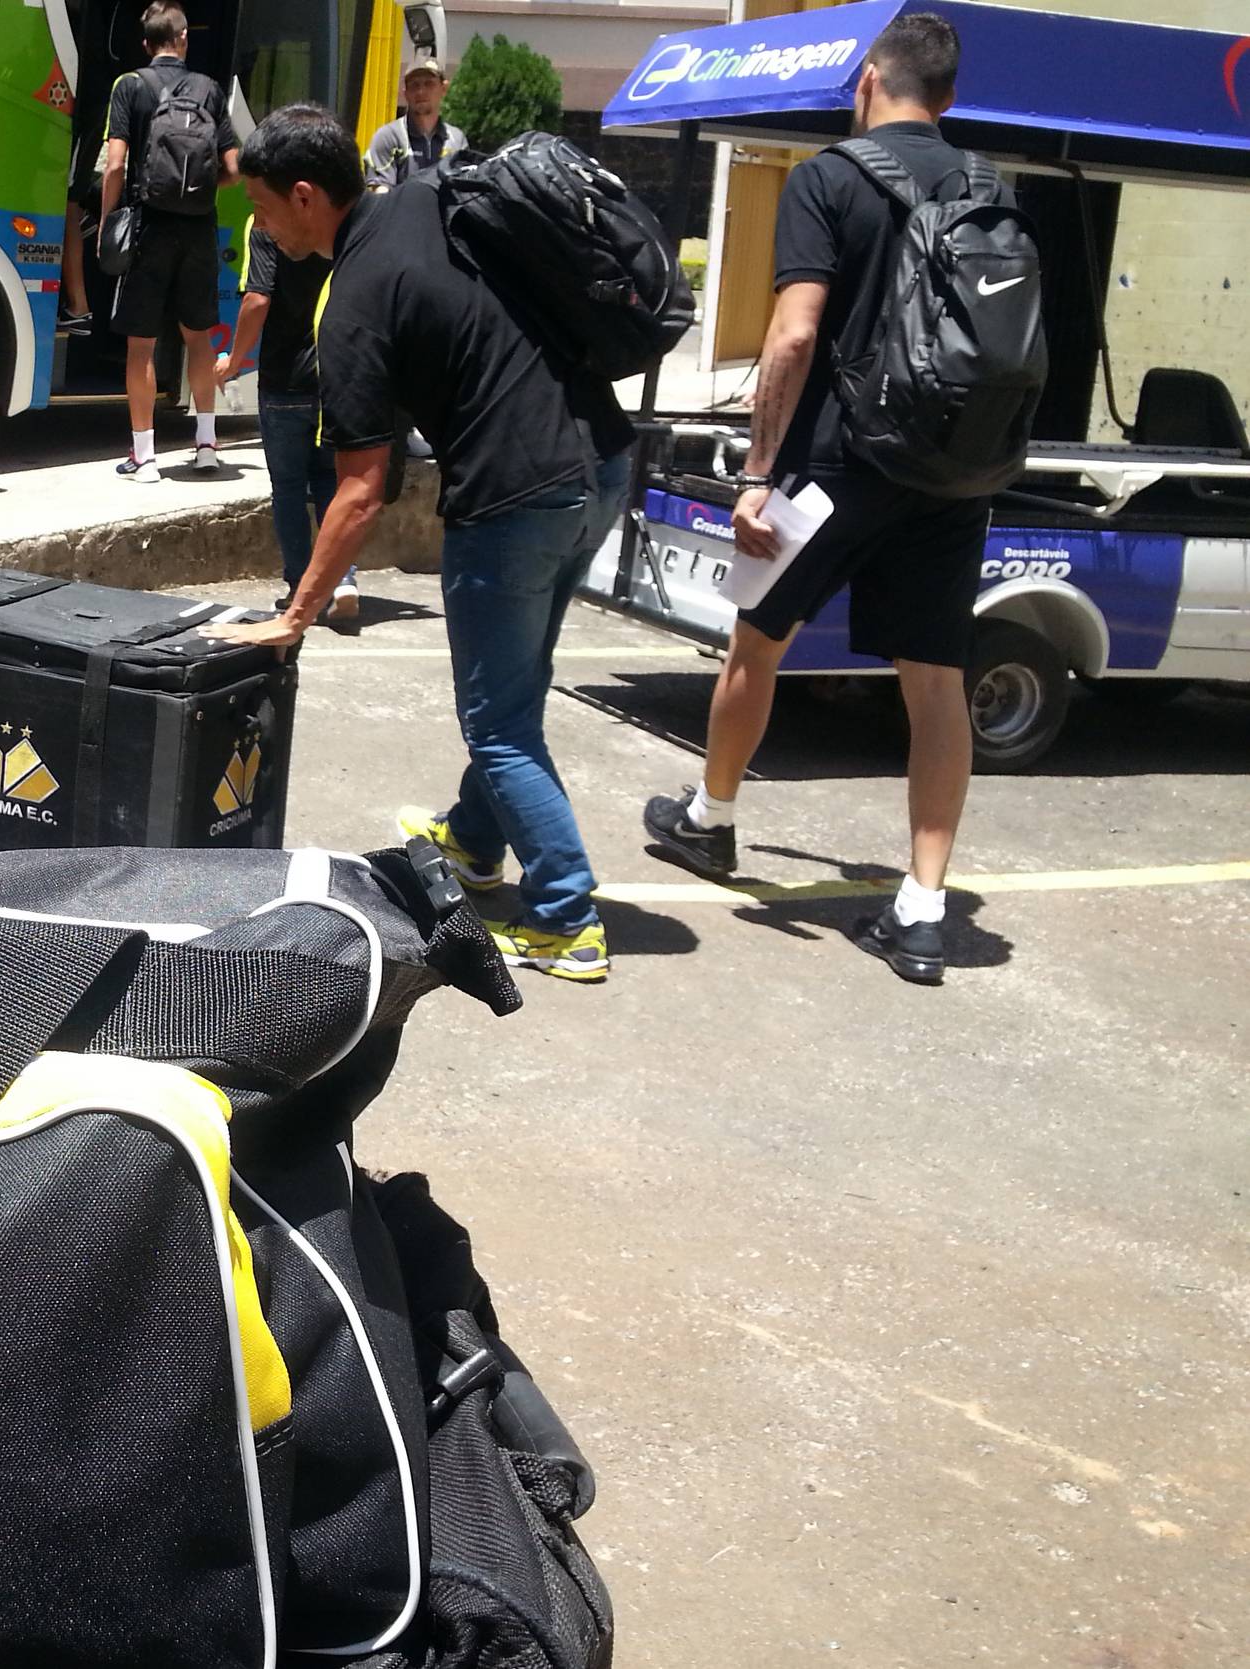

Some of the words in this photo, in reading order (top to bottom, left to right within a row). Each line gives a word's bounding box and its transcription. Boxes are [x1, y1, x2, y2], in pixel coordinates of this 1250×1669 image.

[18, 243, 61, 255] SCANIA
[1004, 547, 1070, 559] Descartáveis
[26, 805, 59, 826] E.C.
